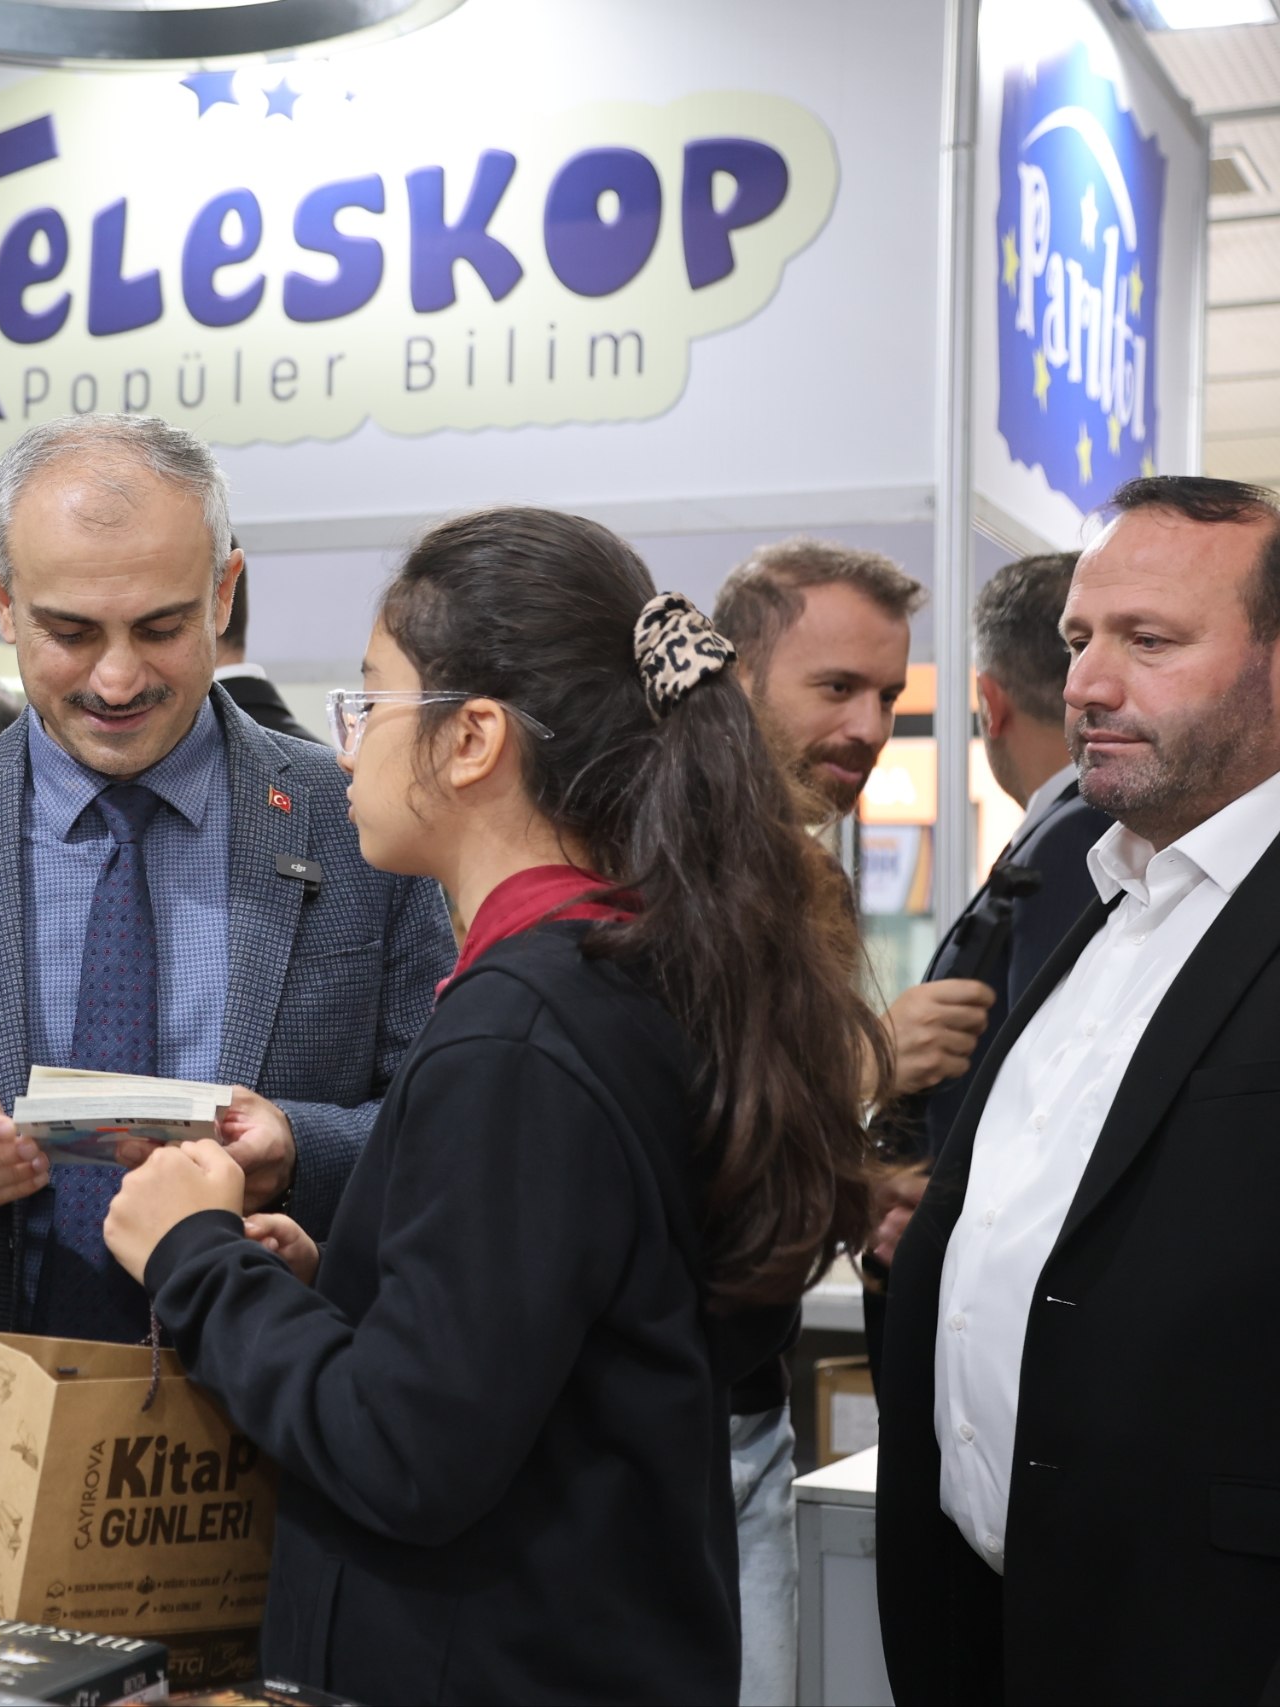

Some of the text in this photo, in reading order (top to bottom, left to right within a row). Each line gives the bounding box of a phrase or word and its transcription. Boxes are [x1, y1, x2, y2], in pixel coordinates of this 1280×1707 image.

[22, 323, 644, 419] Popüler Bilim
[74, 1439, 106, 1550] ÇAYIROVA
